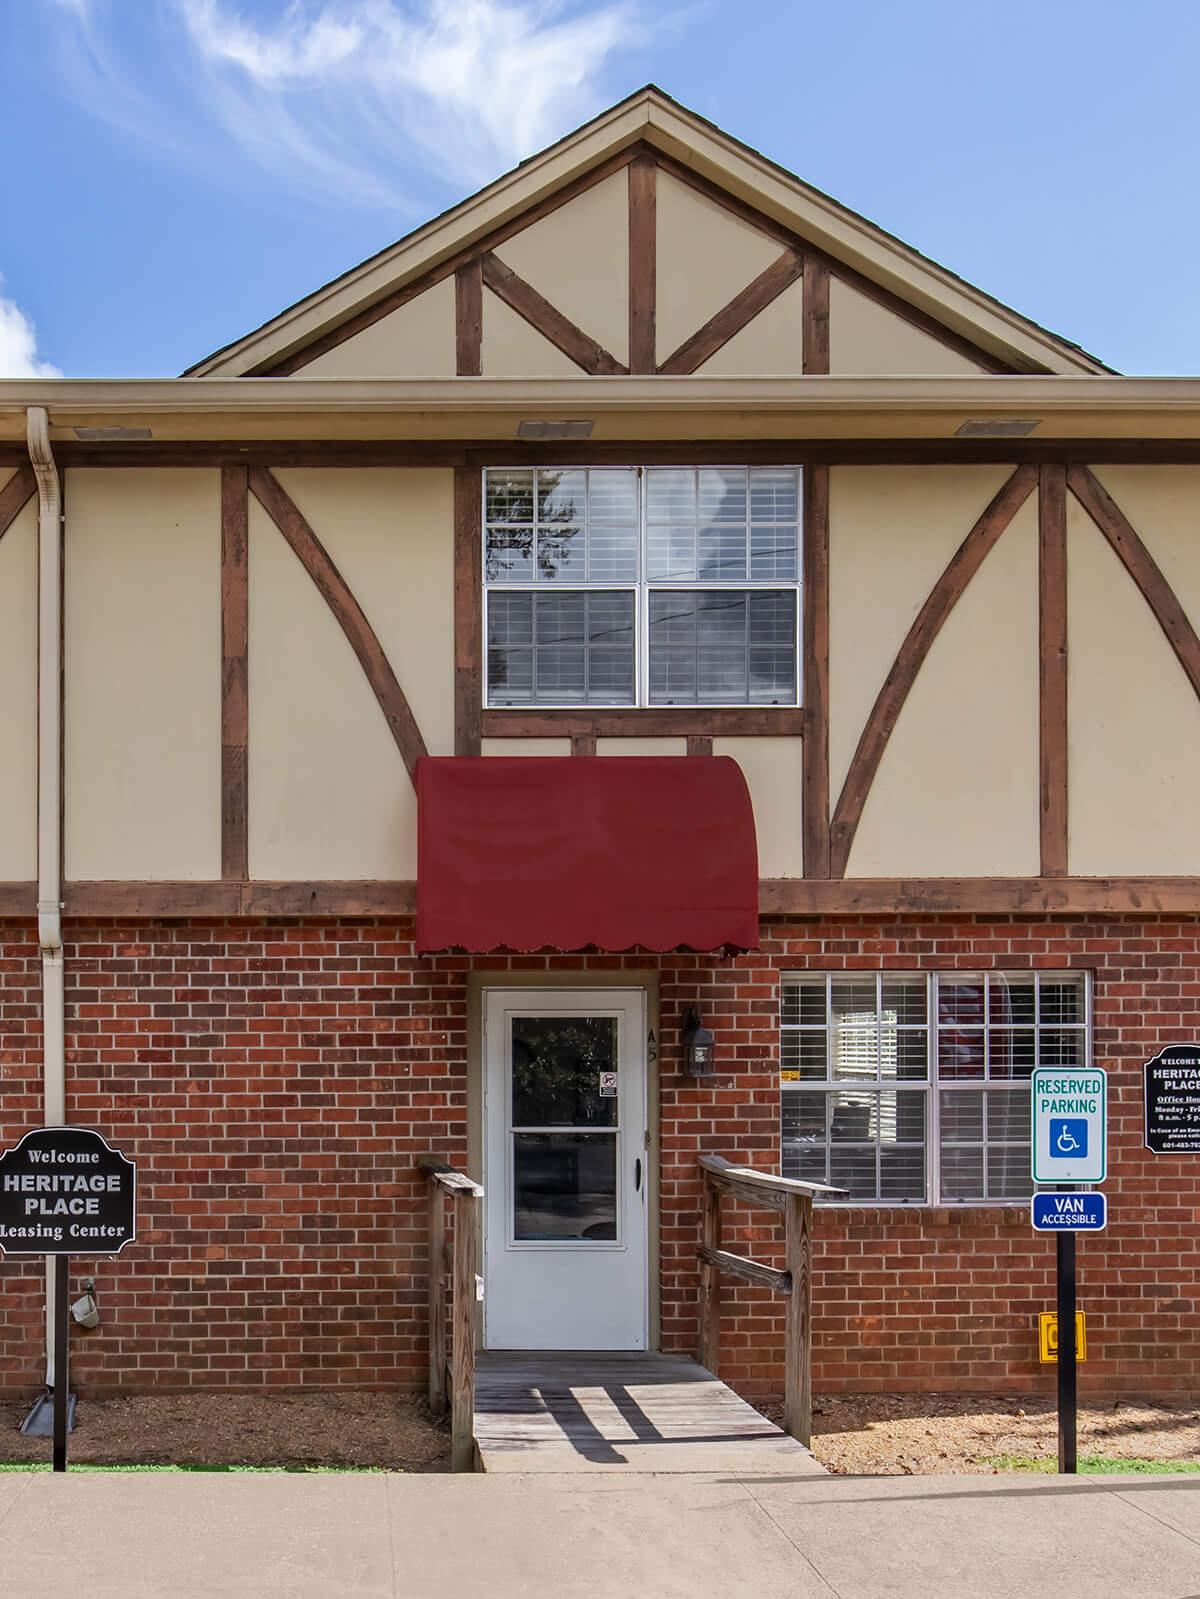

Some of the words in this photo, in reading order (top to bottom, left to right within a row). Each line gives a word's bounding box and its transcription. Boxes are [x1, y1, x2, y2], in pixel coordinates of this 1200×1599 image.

[1037, 1079, 1101, 1094] RESERVED
[1041, 1099, 1097, 1113] PARKING
[1157, 1096, 1184, 1104] Office
[28, 1150, 100, 1164] Welcome
[3, 1175, 121, 1192] HERITAGE
[25, 1198, 100, 1215] PLACE
[1054, 1198, 1084, 1213] VAN
[1041, 1214, 1097, 1225] ACCESSIBLE
[0, 1224, 64, 1241] Leasing
[69, 1224, 125, 1238] Center
